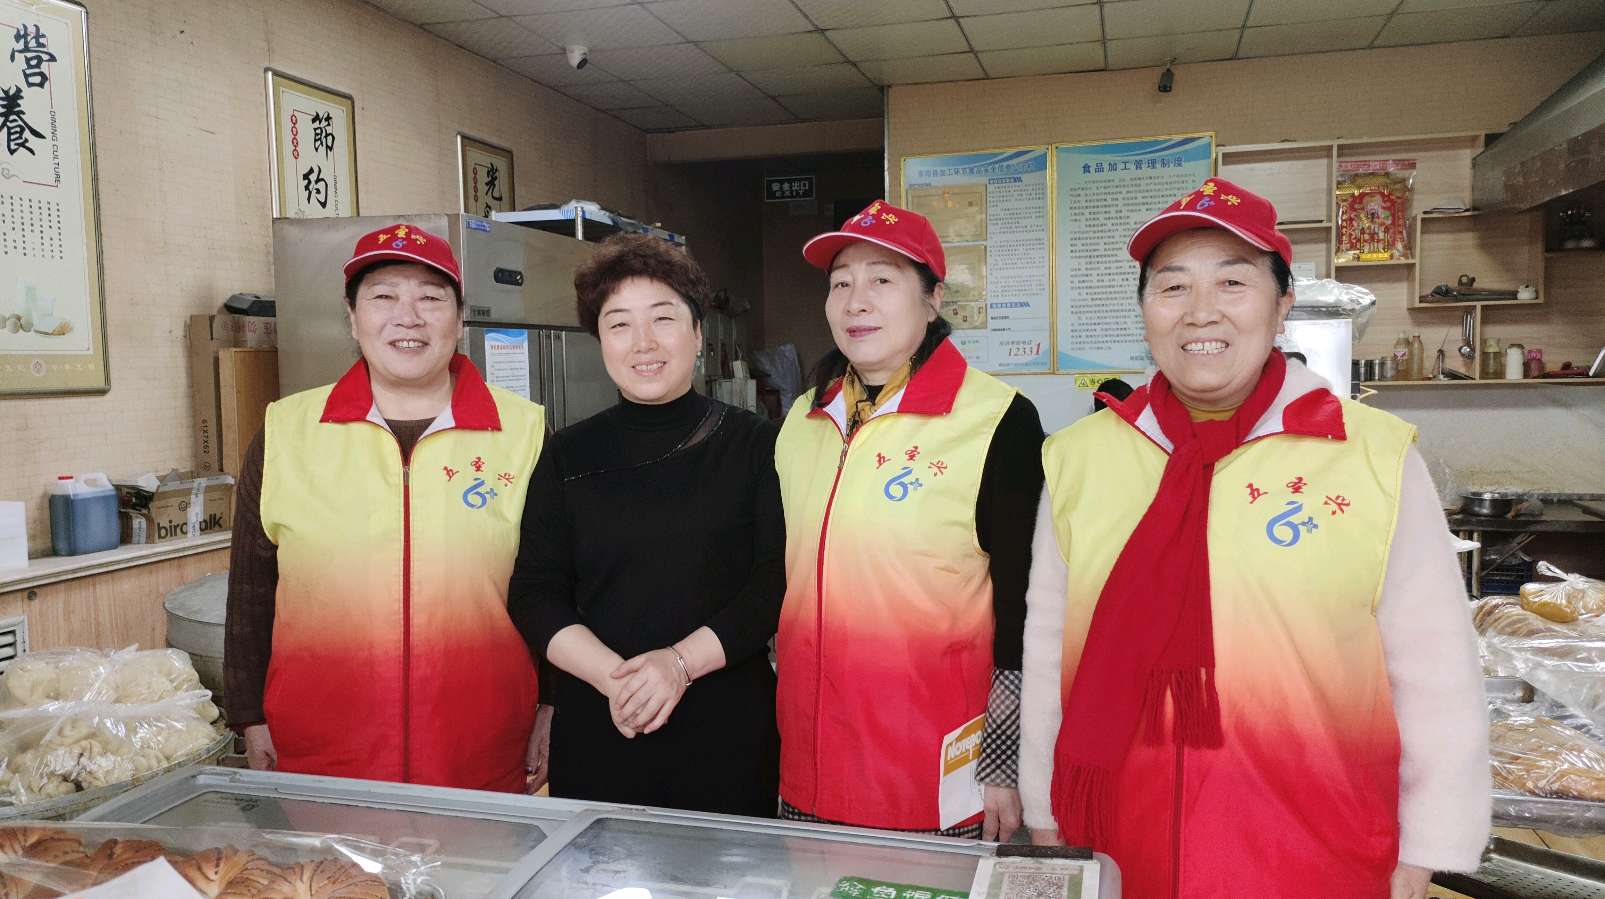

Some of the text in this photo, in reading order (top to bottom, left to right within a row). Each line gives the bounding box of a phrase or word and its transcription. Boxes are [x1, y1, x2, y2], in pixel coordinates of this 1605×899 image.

[50, 110, 61, 184] DINING CULTURE
[1081, 156, 1186, 175] 食品加工管理制度
[1008, 342, 1041, 357] 12331
